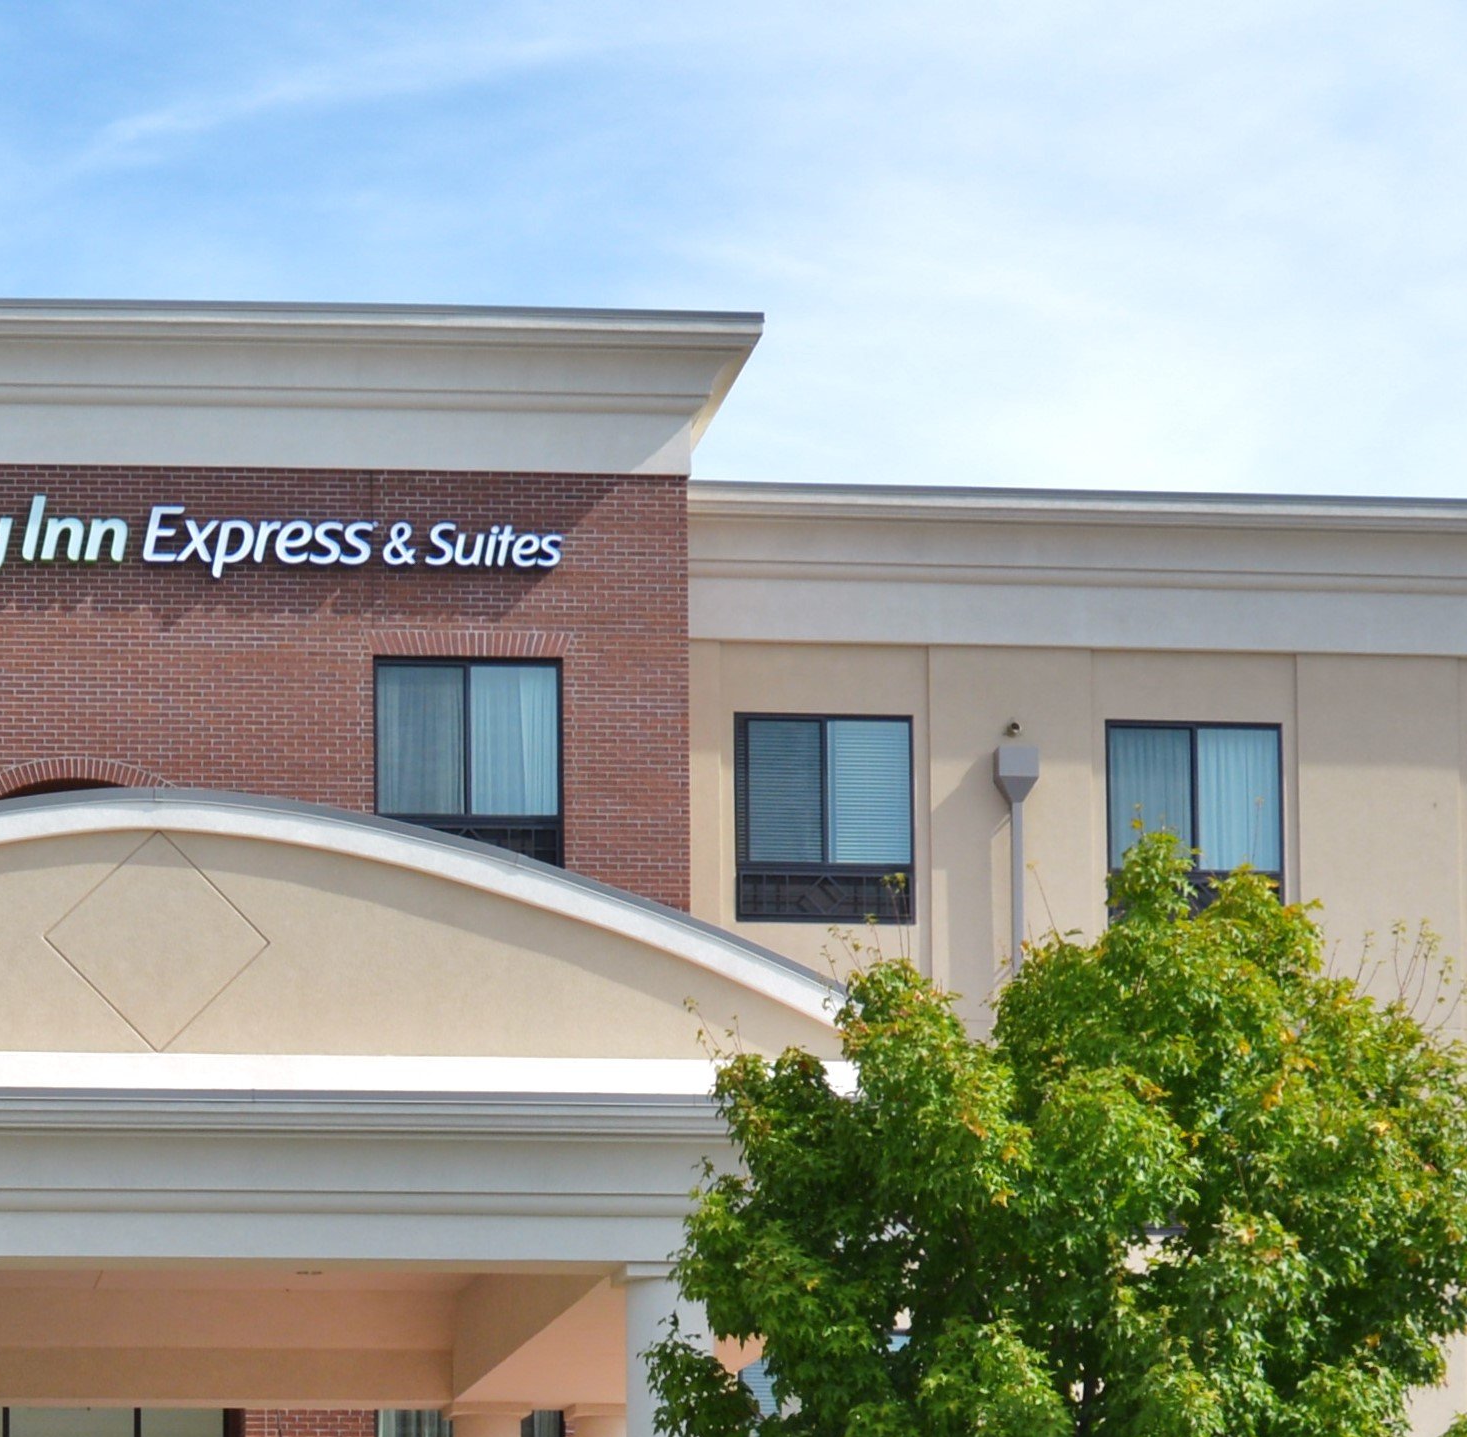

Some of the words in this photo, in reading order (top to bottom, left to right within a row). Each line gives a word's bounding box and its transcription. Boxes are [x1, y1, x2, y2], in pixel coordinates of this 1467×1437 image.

[22, 495, 128, 562] Inn
[142, 505, 375, 578] Express
[382, 521, 416, 566] &
[425, 522, 563, 567] Suites
